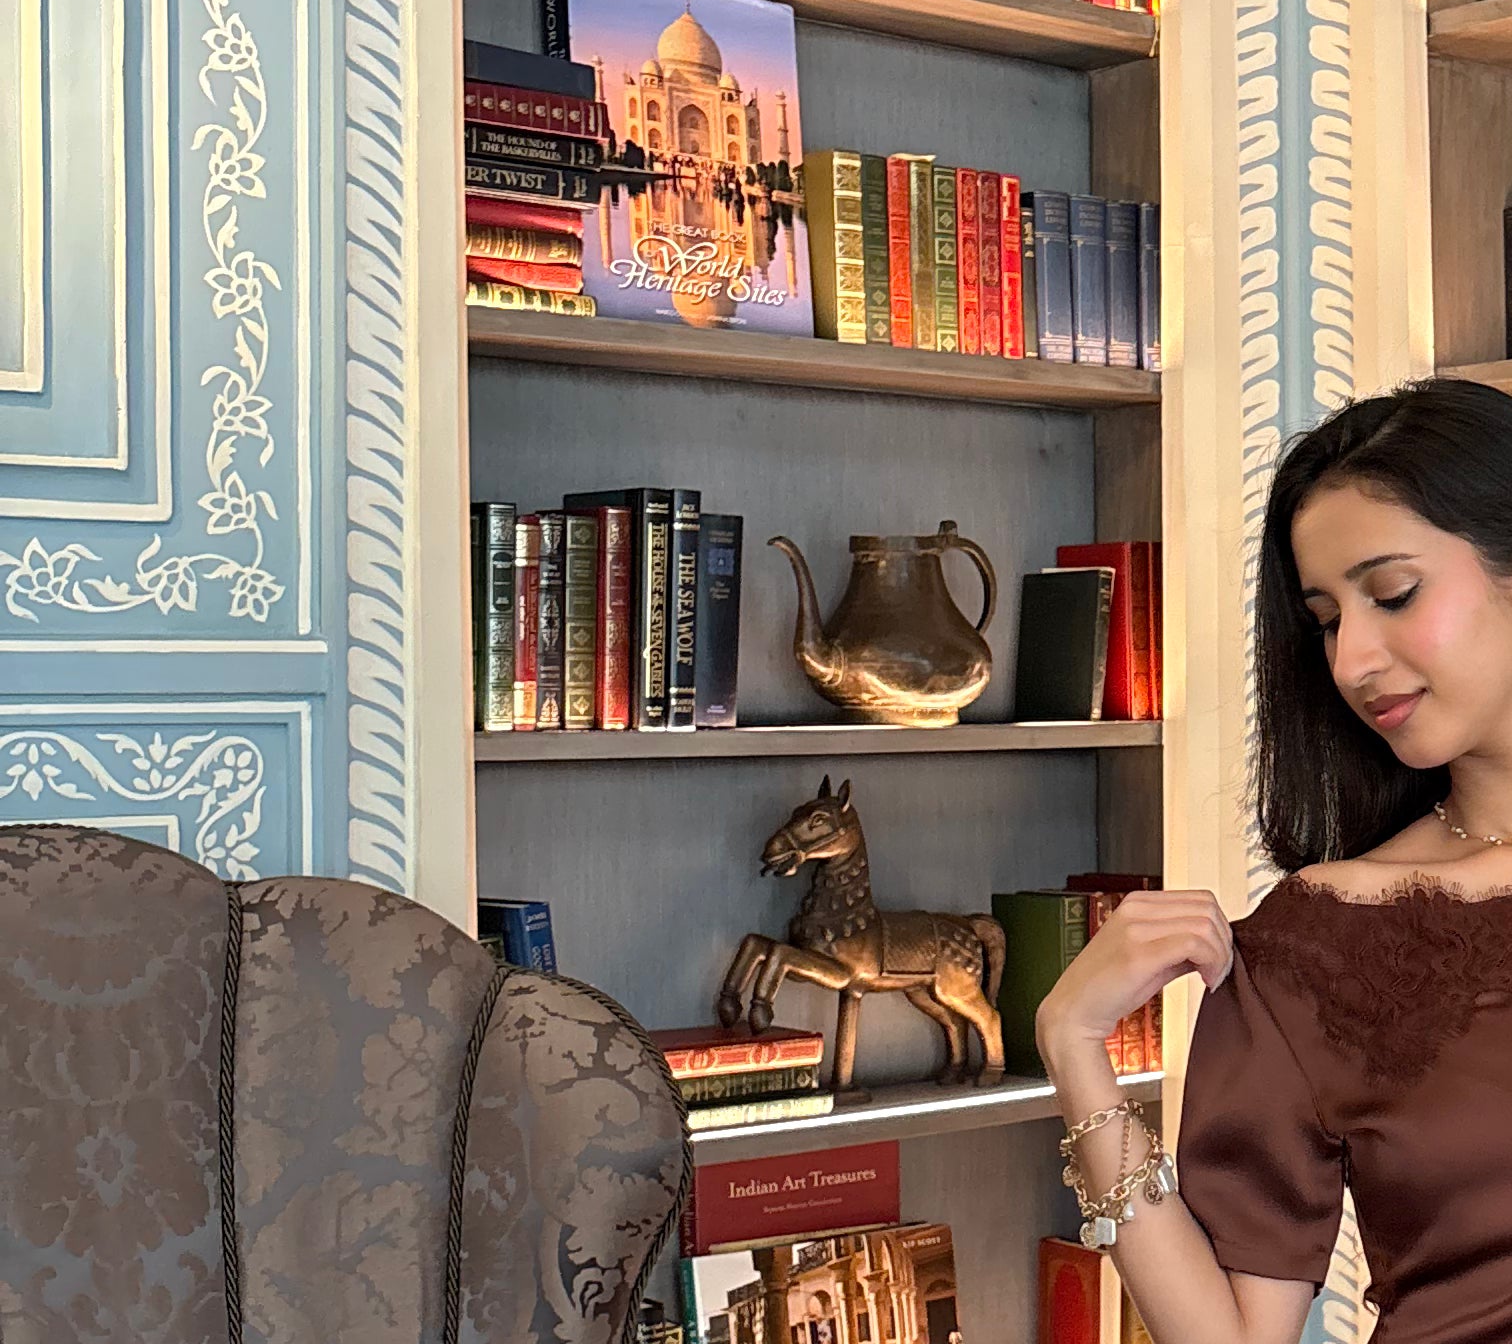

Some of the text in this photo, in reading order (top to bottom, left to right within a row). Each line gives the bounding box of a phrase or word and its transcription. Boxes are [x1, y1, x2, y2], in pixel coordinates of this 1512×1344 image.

[480, 141, 501, 153] THE
[487, 132, 558, 151] THE HOUND OF
[465, 166, 547, 190] ER TWIST
[672, 224, 709, 237] GREAT
[633, 234, 745, 279] World
[610, 259, 788, 306] Heritage Sites
[652, 524, 665, 550] THE
[652, 550, 664, 595] HOUSE
[676, 552, 696, 666] THE SEA WOLF
[652, 605, 664, 648] SEVEN
[728, 1168, 877, 1199] Indian Art Treasures
